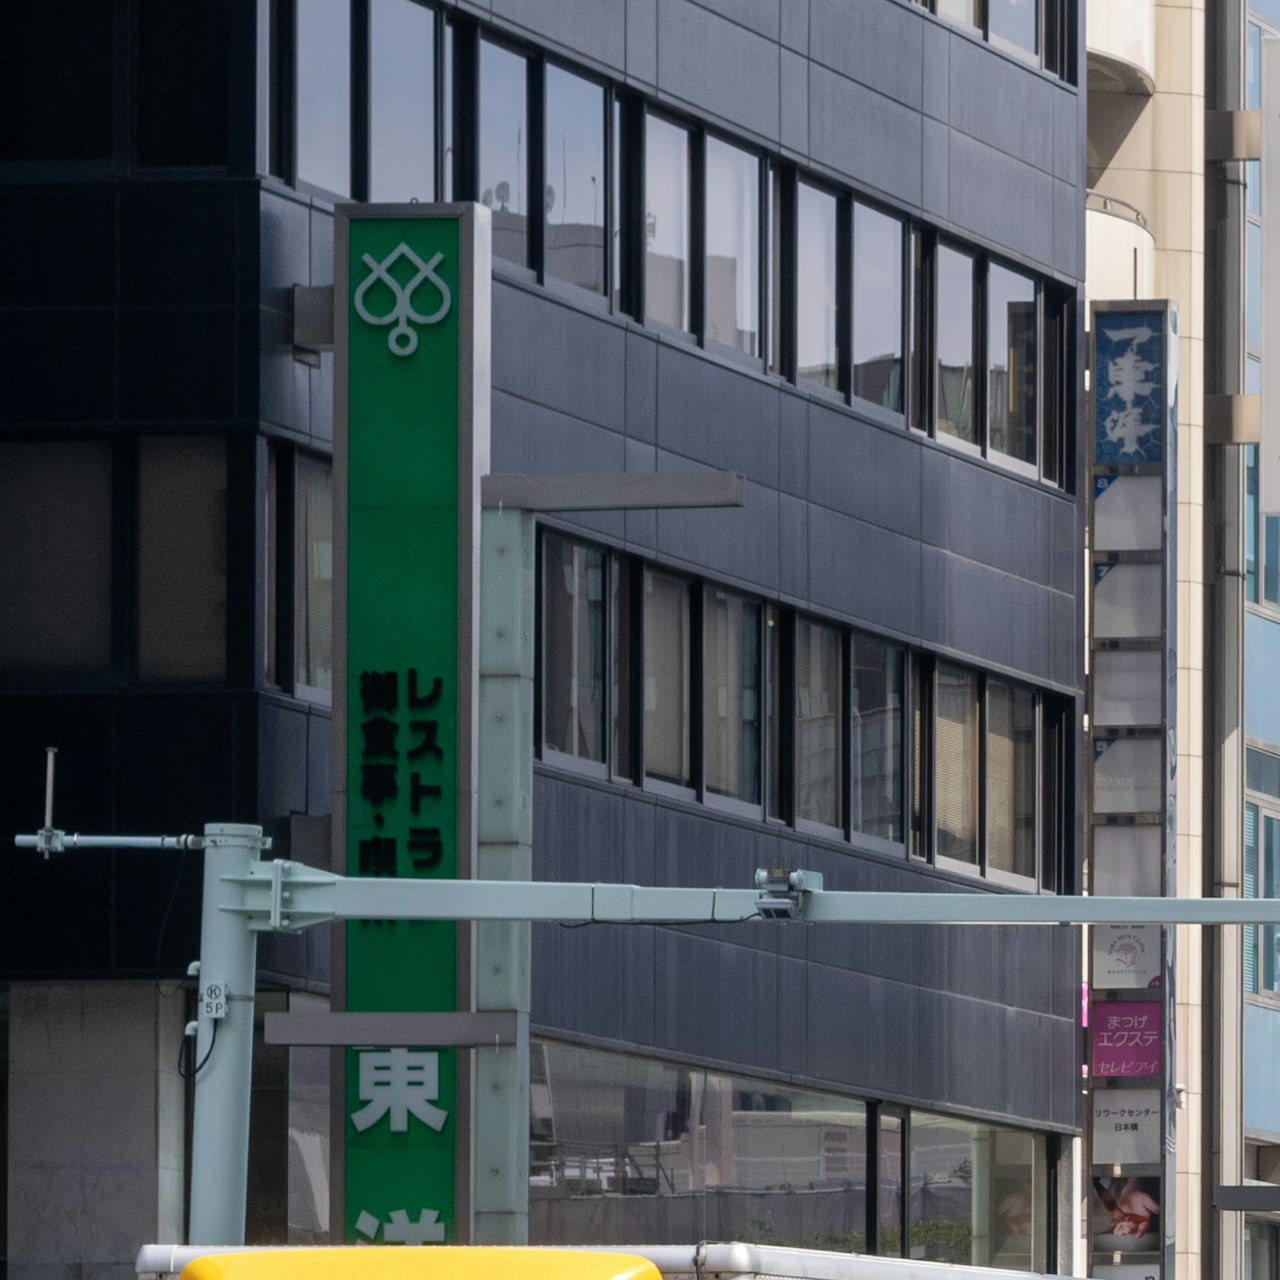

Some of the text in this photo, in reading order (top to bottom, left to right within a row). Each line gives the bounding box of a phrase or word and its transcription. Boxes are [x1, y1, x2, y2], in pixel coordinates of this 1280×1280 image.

[407, 668, 444, 868] レストラ
[1107, 1016, 1148, 1029] まつげ
[1098, 1032, 1158, 1047] エクステ
[1096, 1108, 1159, 1117] リワークセンター
